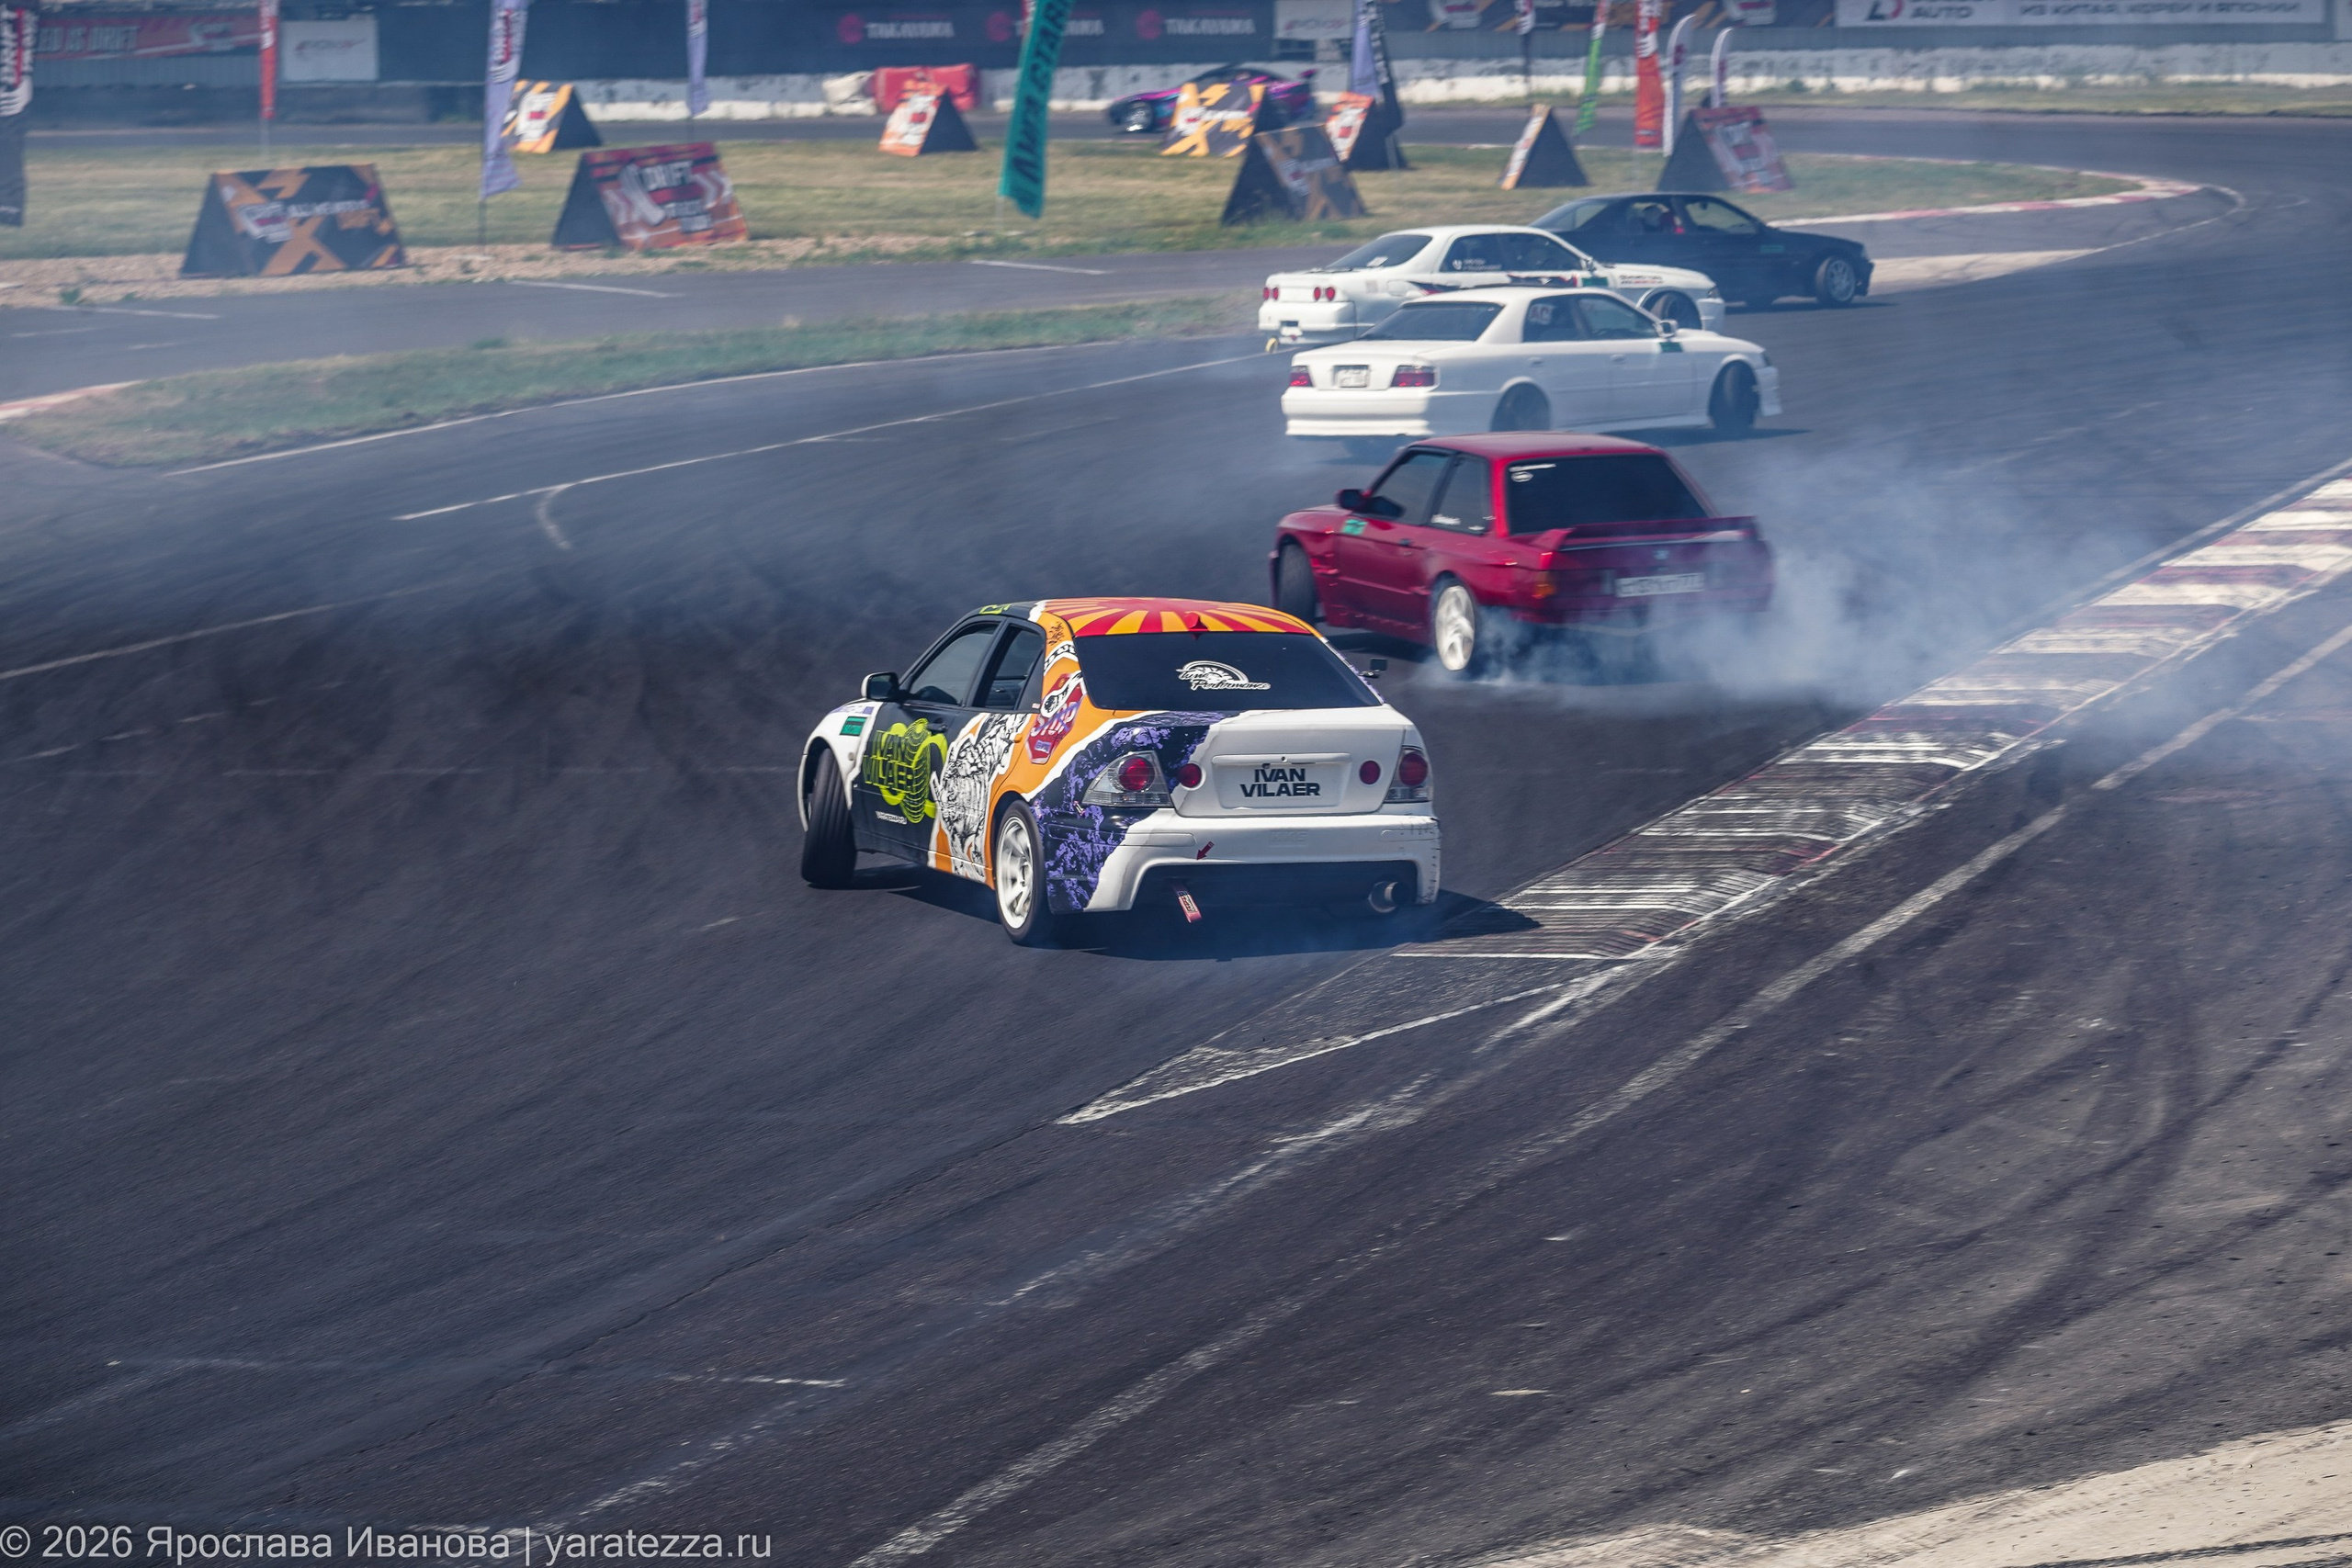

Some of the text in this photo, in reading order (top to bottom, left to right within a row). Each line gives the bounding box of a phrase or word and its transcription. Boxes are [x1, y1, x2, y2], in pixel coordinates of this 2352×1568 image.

[1910, 6, 1973, 19] AUTO
[1254, 768, 1306, 783] IVAN
[1239, 783, 1320, 797] VILAER
